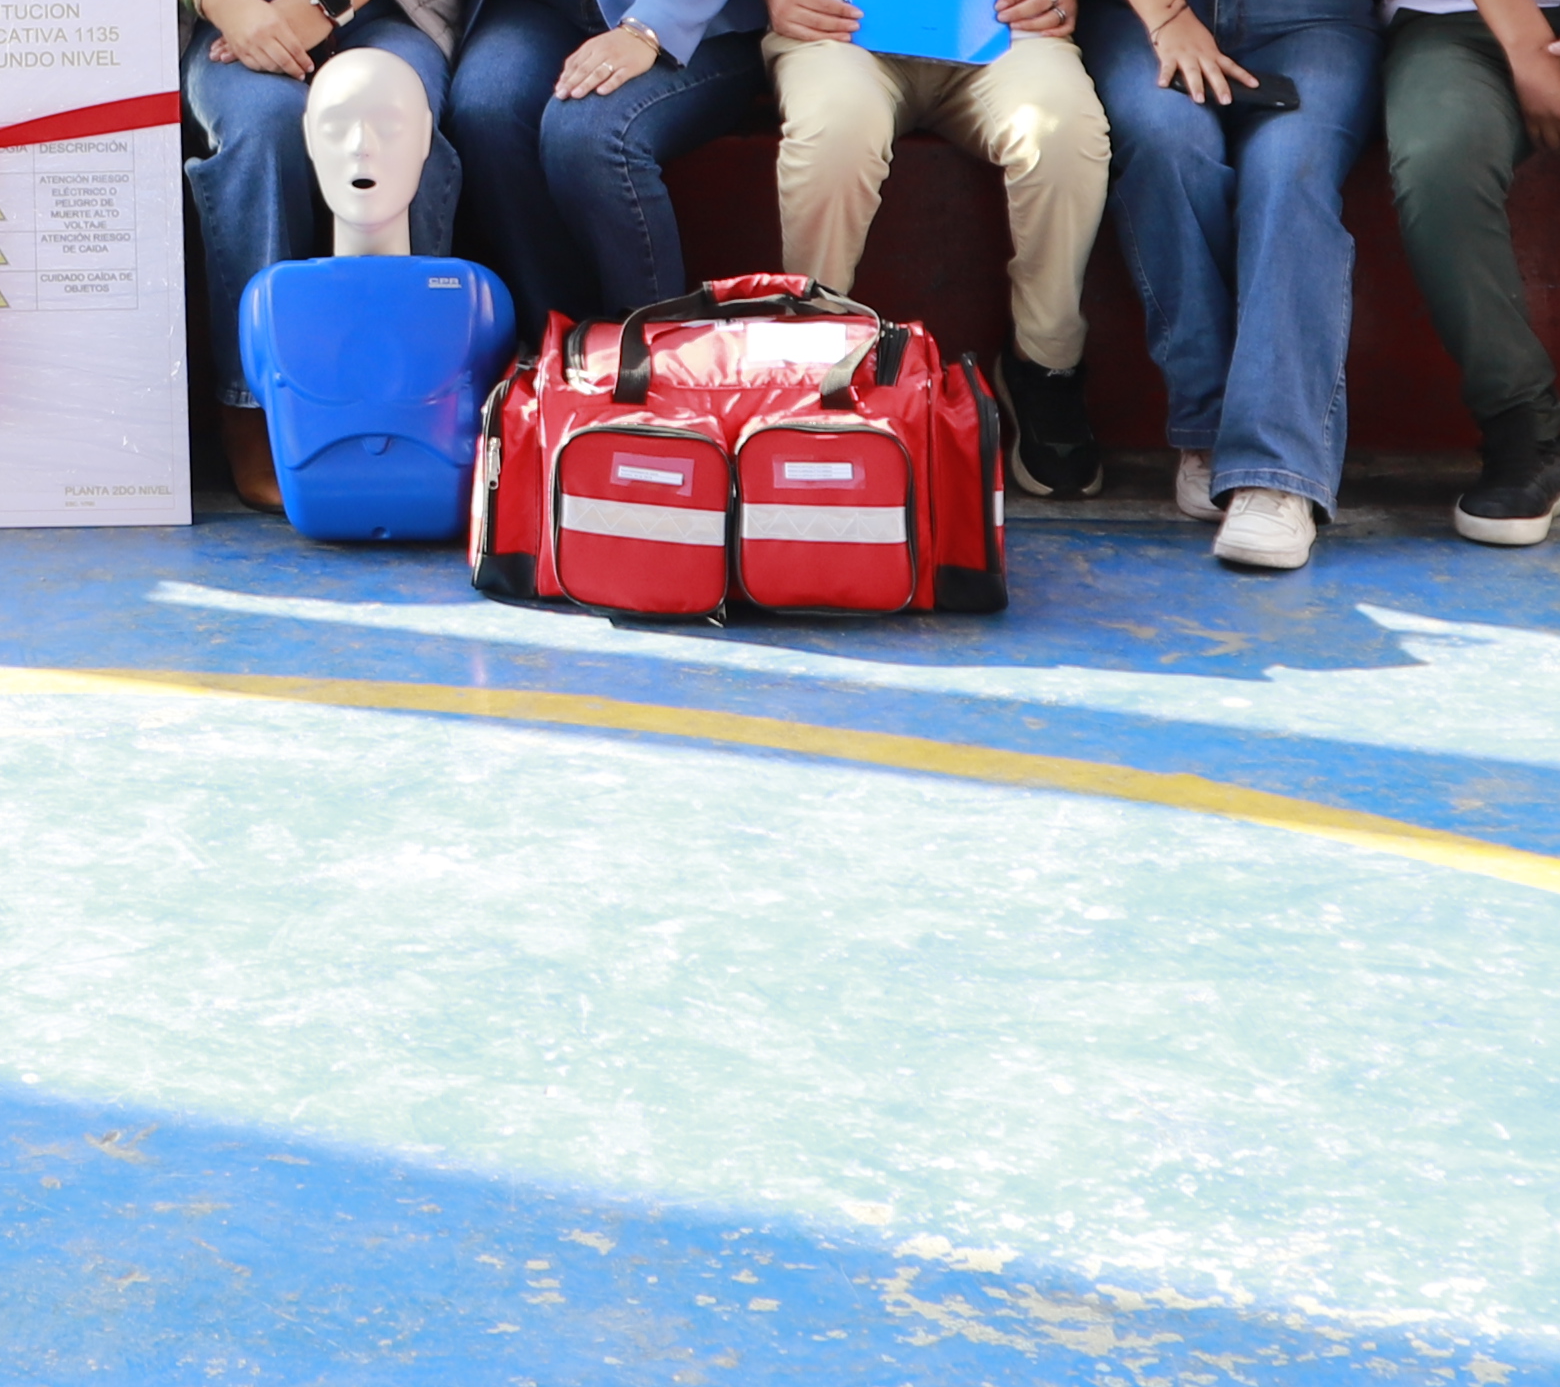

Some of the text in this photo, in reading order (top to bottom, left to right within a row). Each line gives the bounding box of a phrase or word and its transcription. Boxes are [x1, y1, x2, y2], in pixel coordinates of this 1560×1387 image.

[75, 26, 120, 43] 1135
[62, 50, 122, 67] NIVEL
[39, 140, 128, 154] DESCRIPCIÓN
[40, 174, 129, 185] ATENCIÓN RIESGO
[51, 186, 117, 197] ELÉCTRICO O
[55, 199, 114, 208] PELIGRO DE
[50, 209, 119, 219] MUERTE ALTO
[63, 221, 108, 231] VOLTAJE
[41, 232, 131, 243] ATENCIÓN RIESGO
[62, 244, 109, 254] DE CAIDA
[40, 273, 86, 282] CUIDADO
[119, 272, 133, 281] DE
[64, 284, 110, 293] OBJETOS
[64, 485, 172, 497] PLANTA 2DO NIVEL
